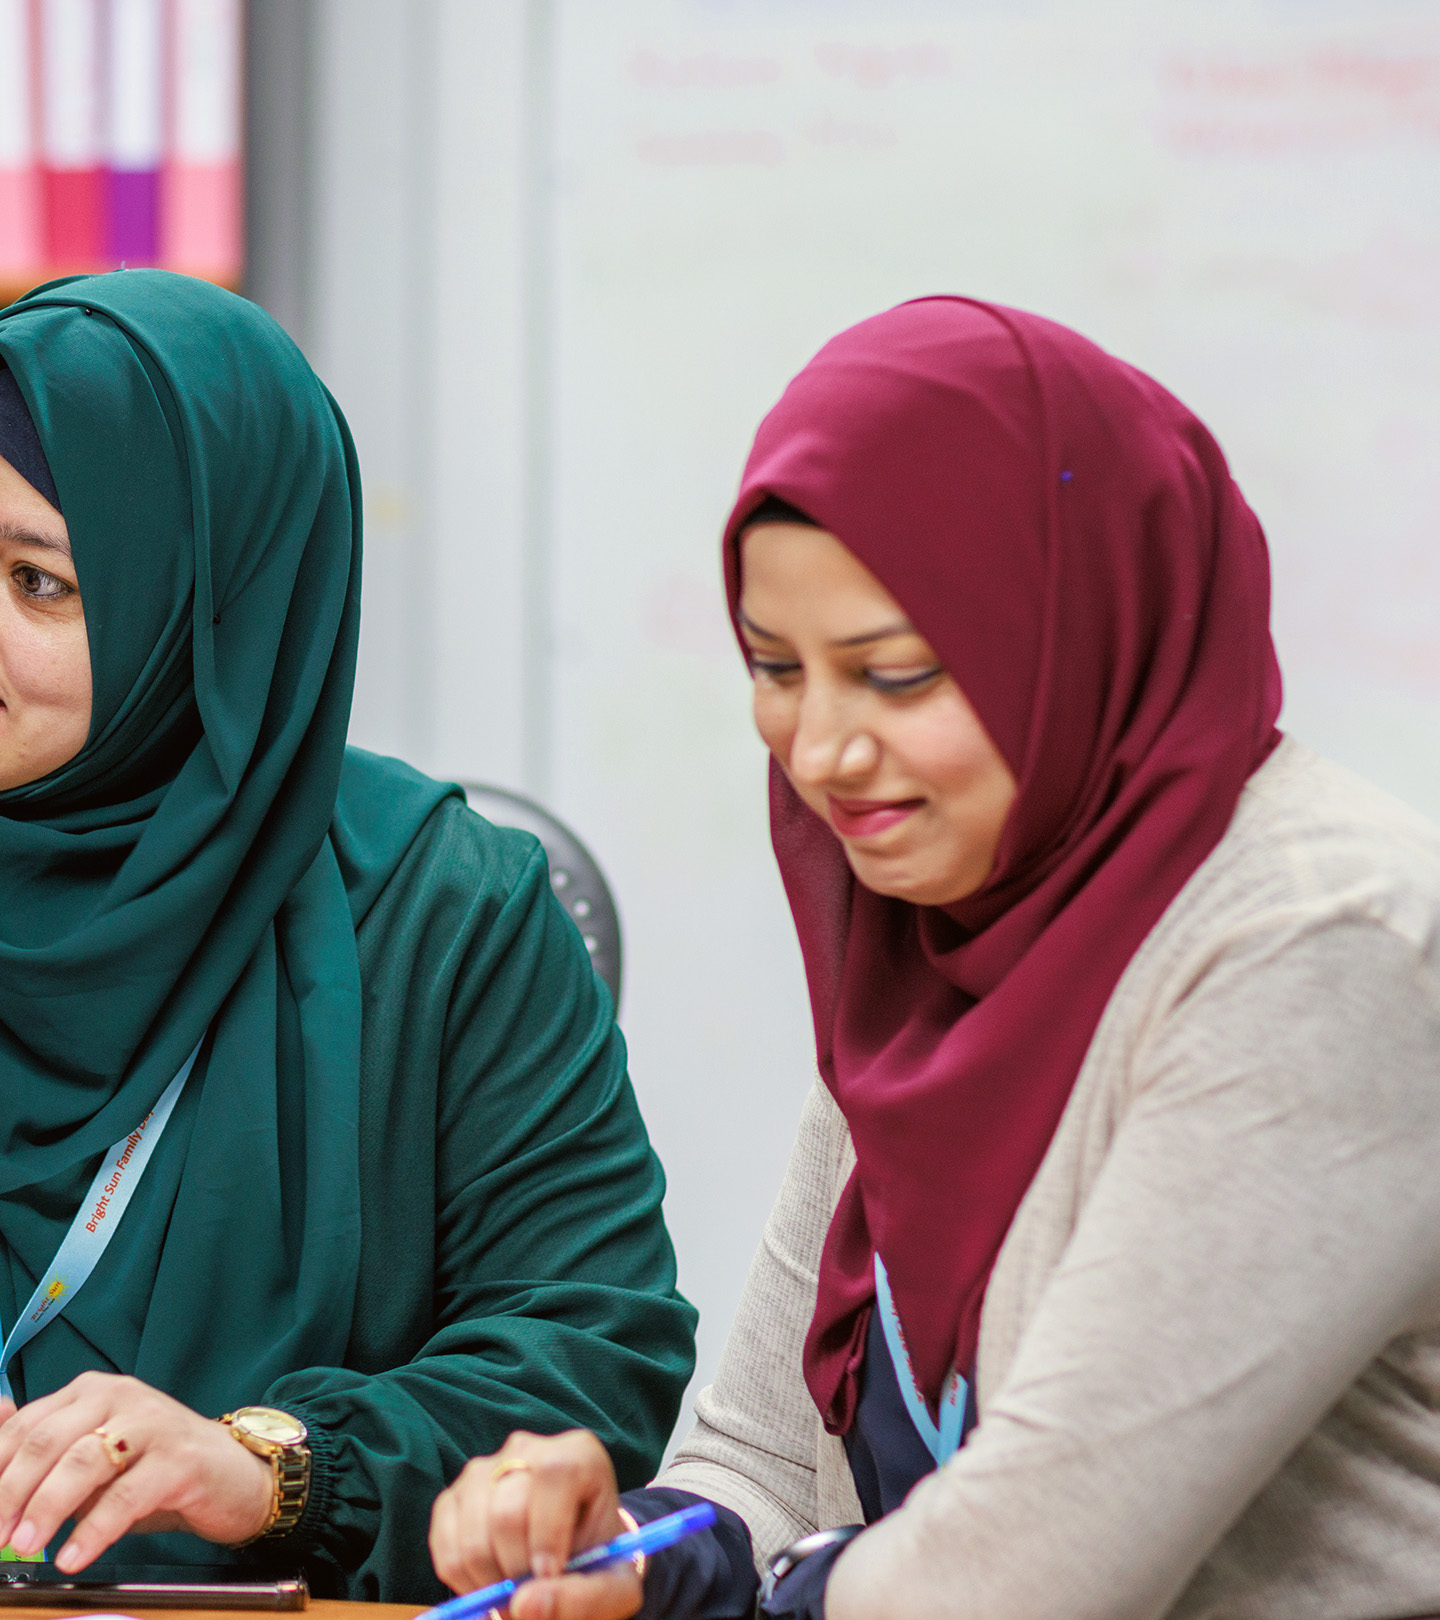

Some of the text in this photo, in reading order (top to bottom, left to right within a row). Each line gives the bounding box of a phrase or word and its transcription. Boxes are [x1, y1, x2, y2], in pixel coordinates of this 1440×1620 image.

[85, 1195, 110, 1233] Bright
[104, 1171, 122, 1195] Sun
[115, 1130, 142, 1170] Family
